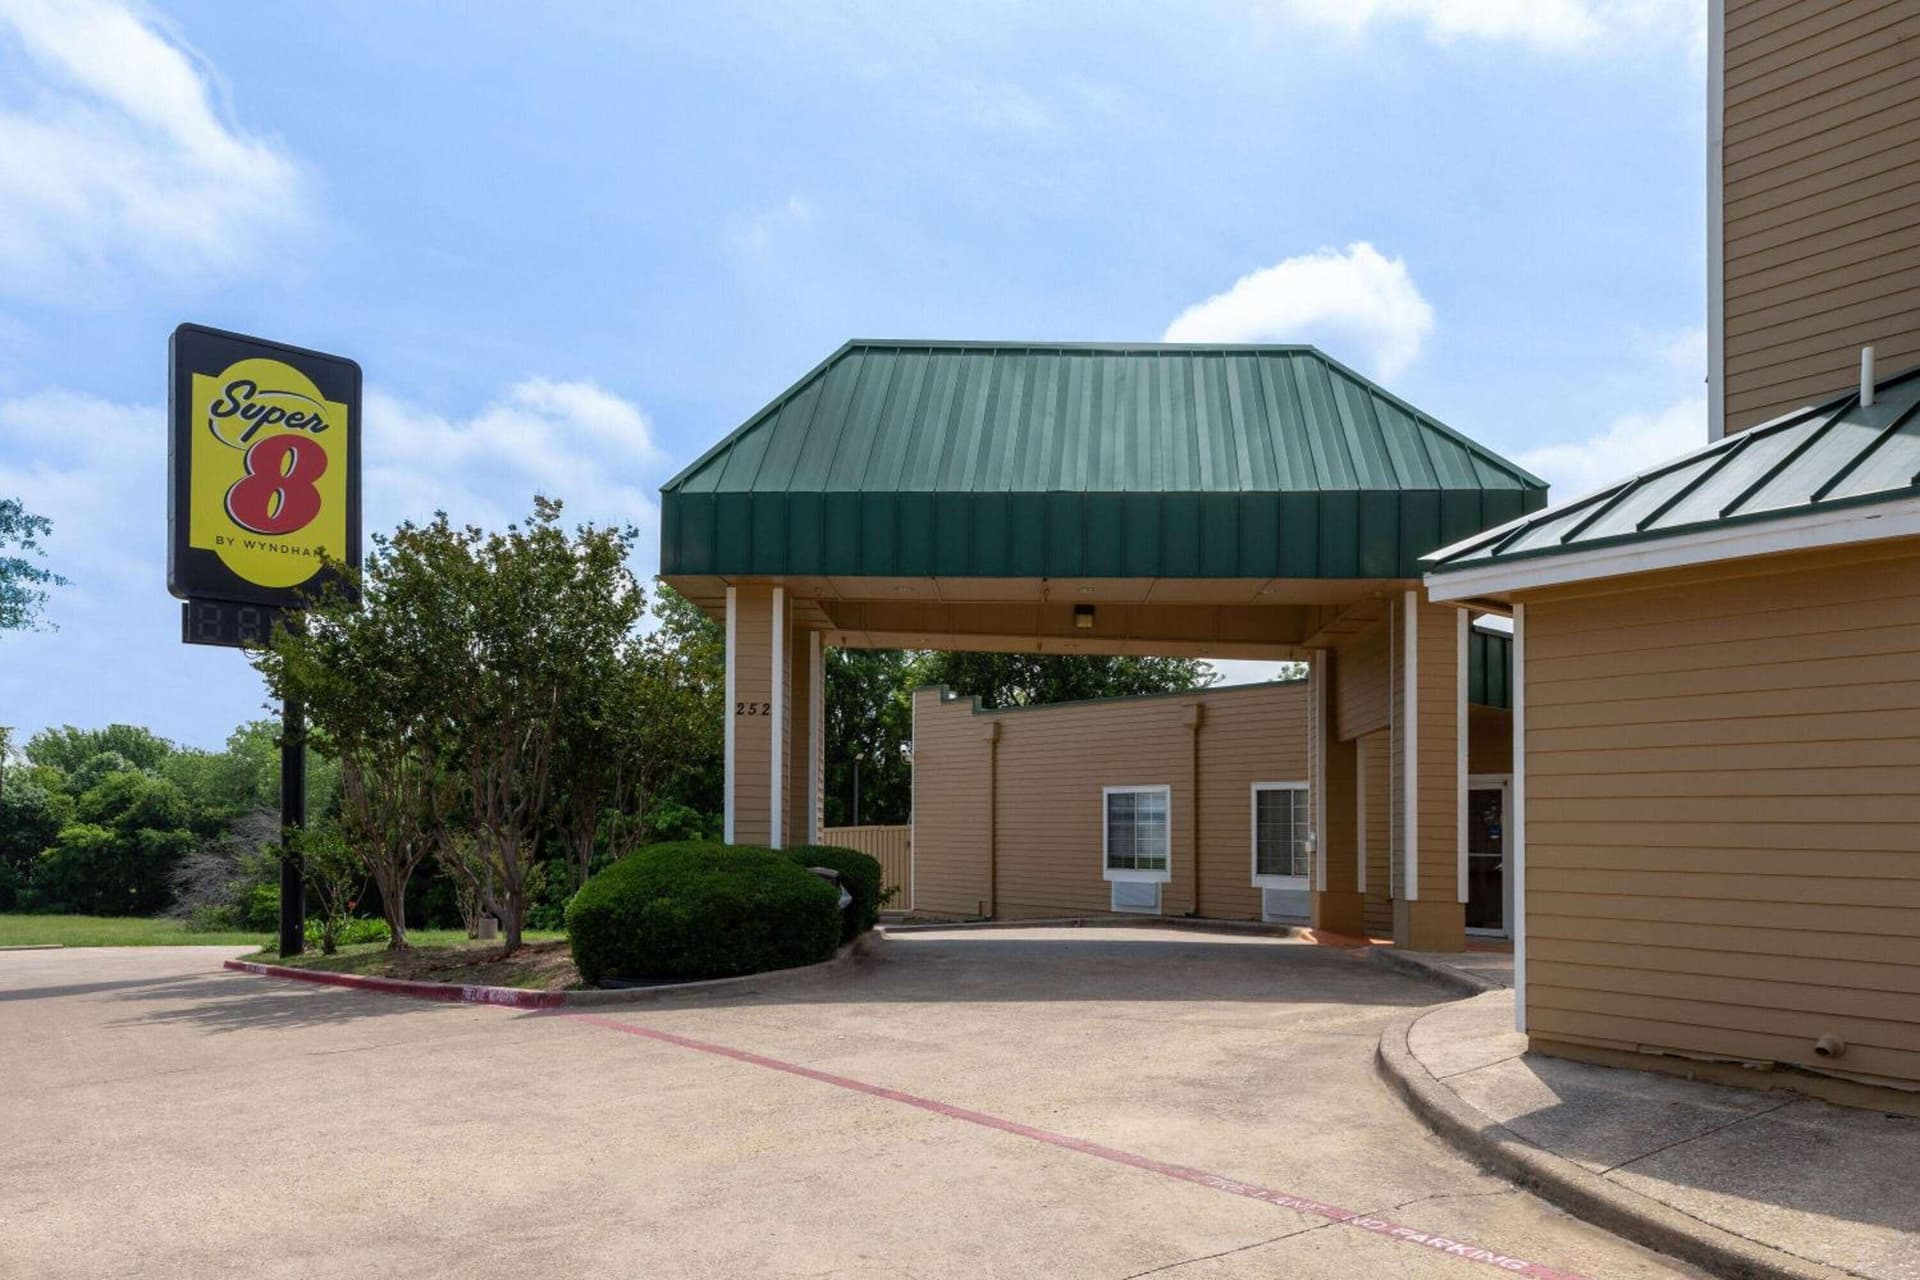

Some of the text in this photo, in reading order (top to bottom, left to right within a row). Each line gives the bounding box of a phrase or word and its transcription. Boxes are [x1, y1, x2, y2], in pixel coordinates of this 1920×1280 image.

[210, 379, 330, 443] Super
[224, 434, 328, 536] 8
[215, 535, 235, 546] BY
[736, 702, 770, 716] 252
[1342, 1216, 1388, 1230] NO
[1390, 1226, 1529, 1271] PARKING
